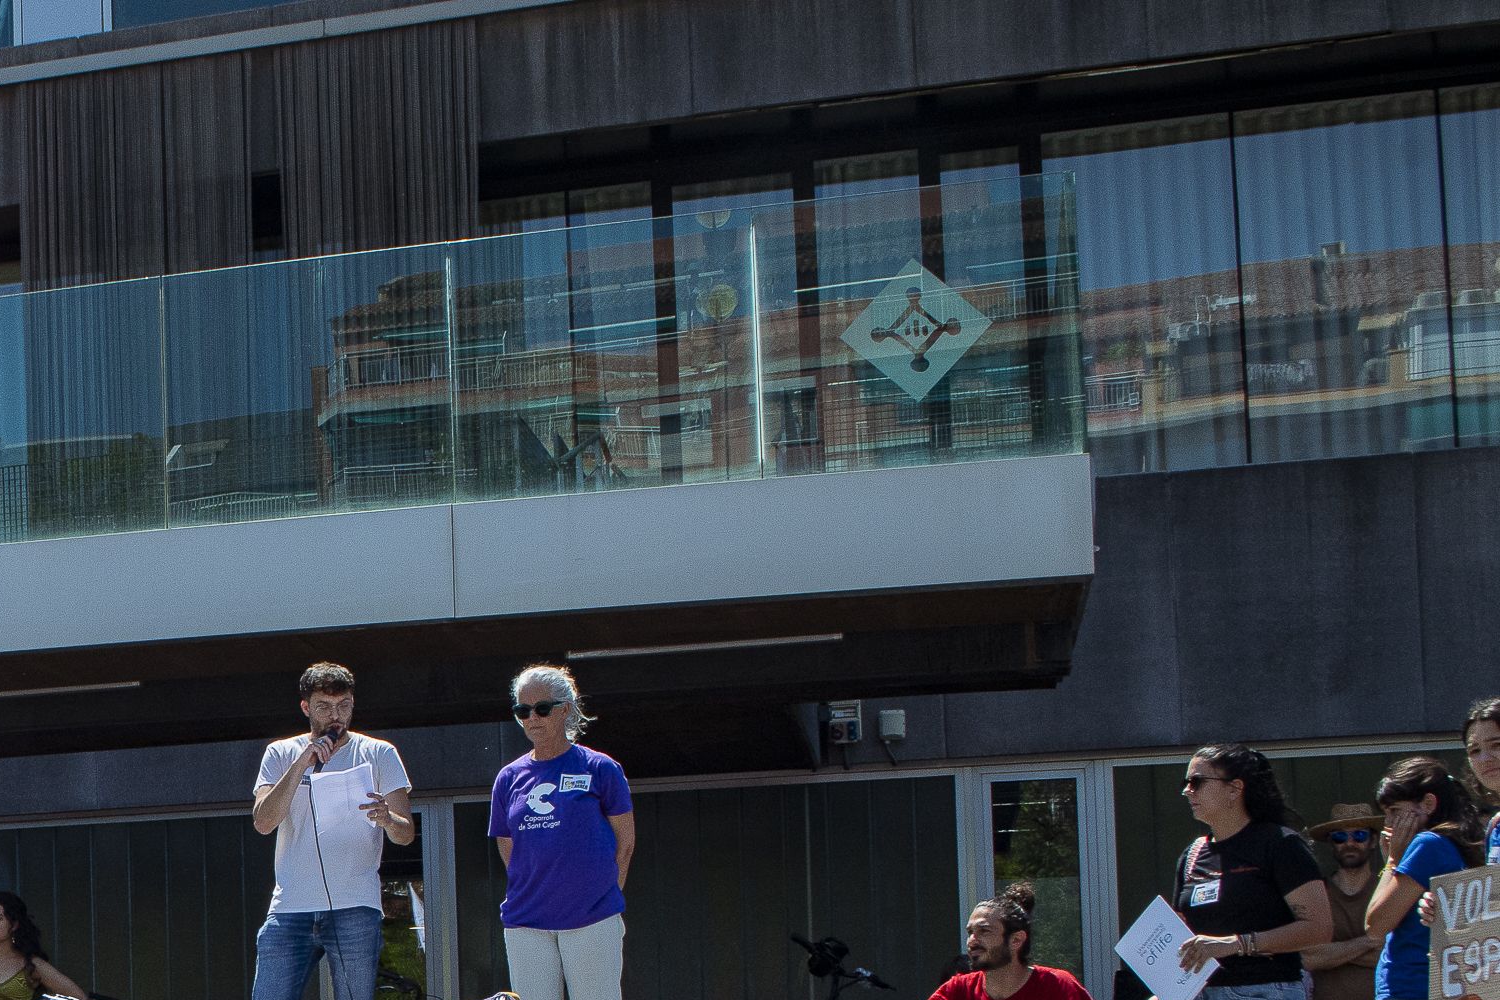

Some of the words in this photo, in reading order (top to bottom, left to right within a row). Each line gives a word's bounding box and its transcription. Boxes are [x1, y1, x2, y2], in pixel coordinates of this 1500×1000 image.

[527, 821, 541, 830] Sant
[1146, 949, 1159, 966] of
[1154, 933, 1173, 954] life
[1441, 936, 1500, 998] ESP
